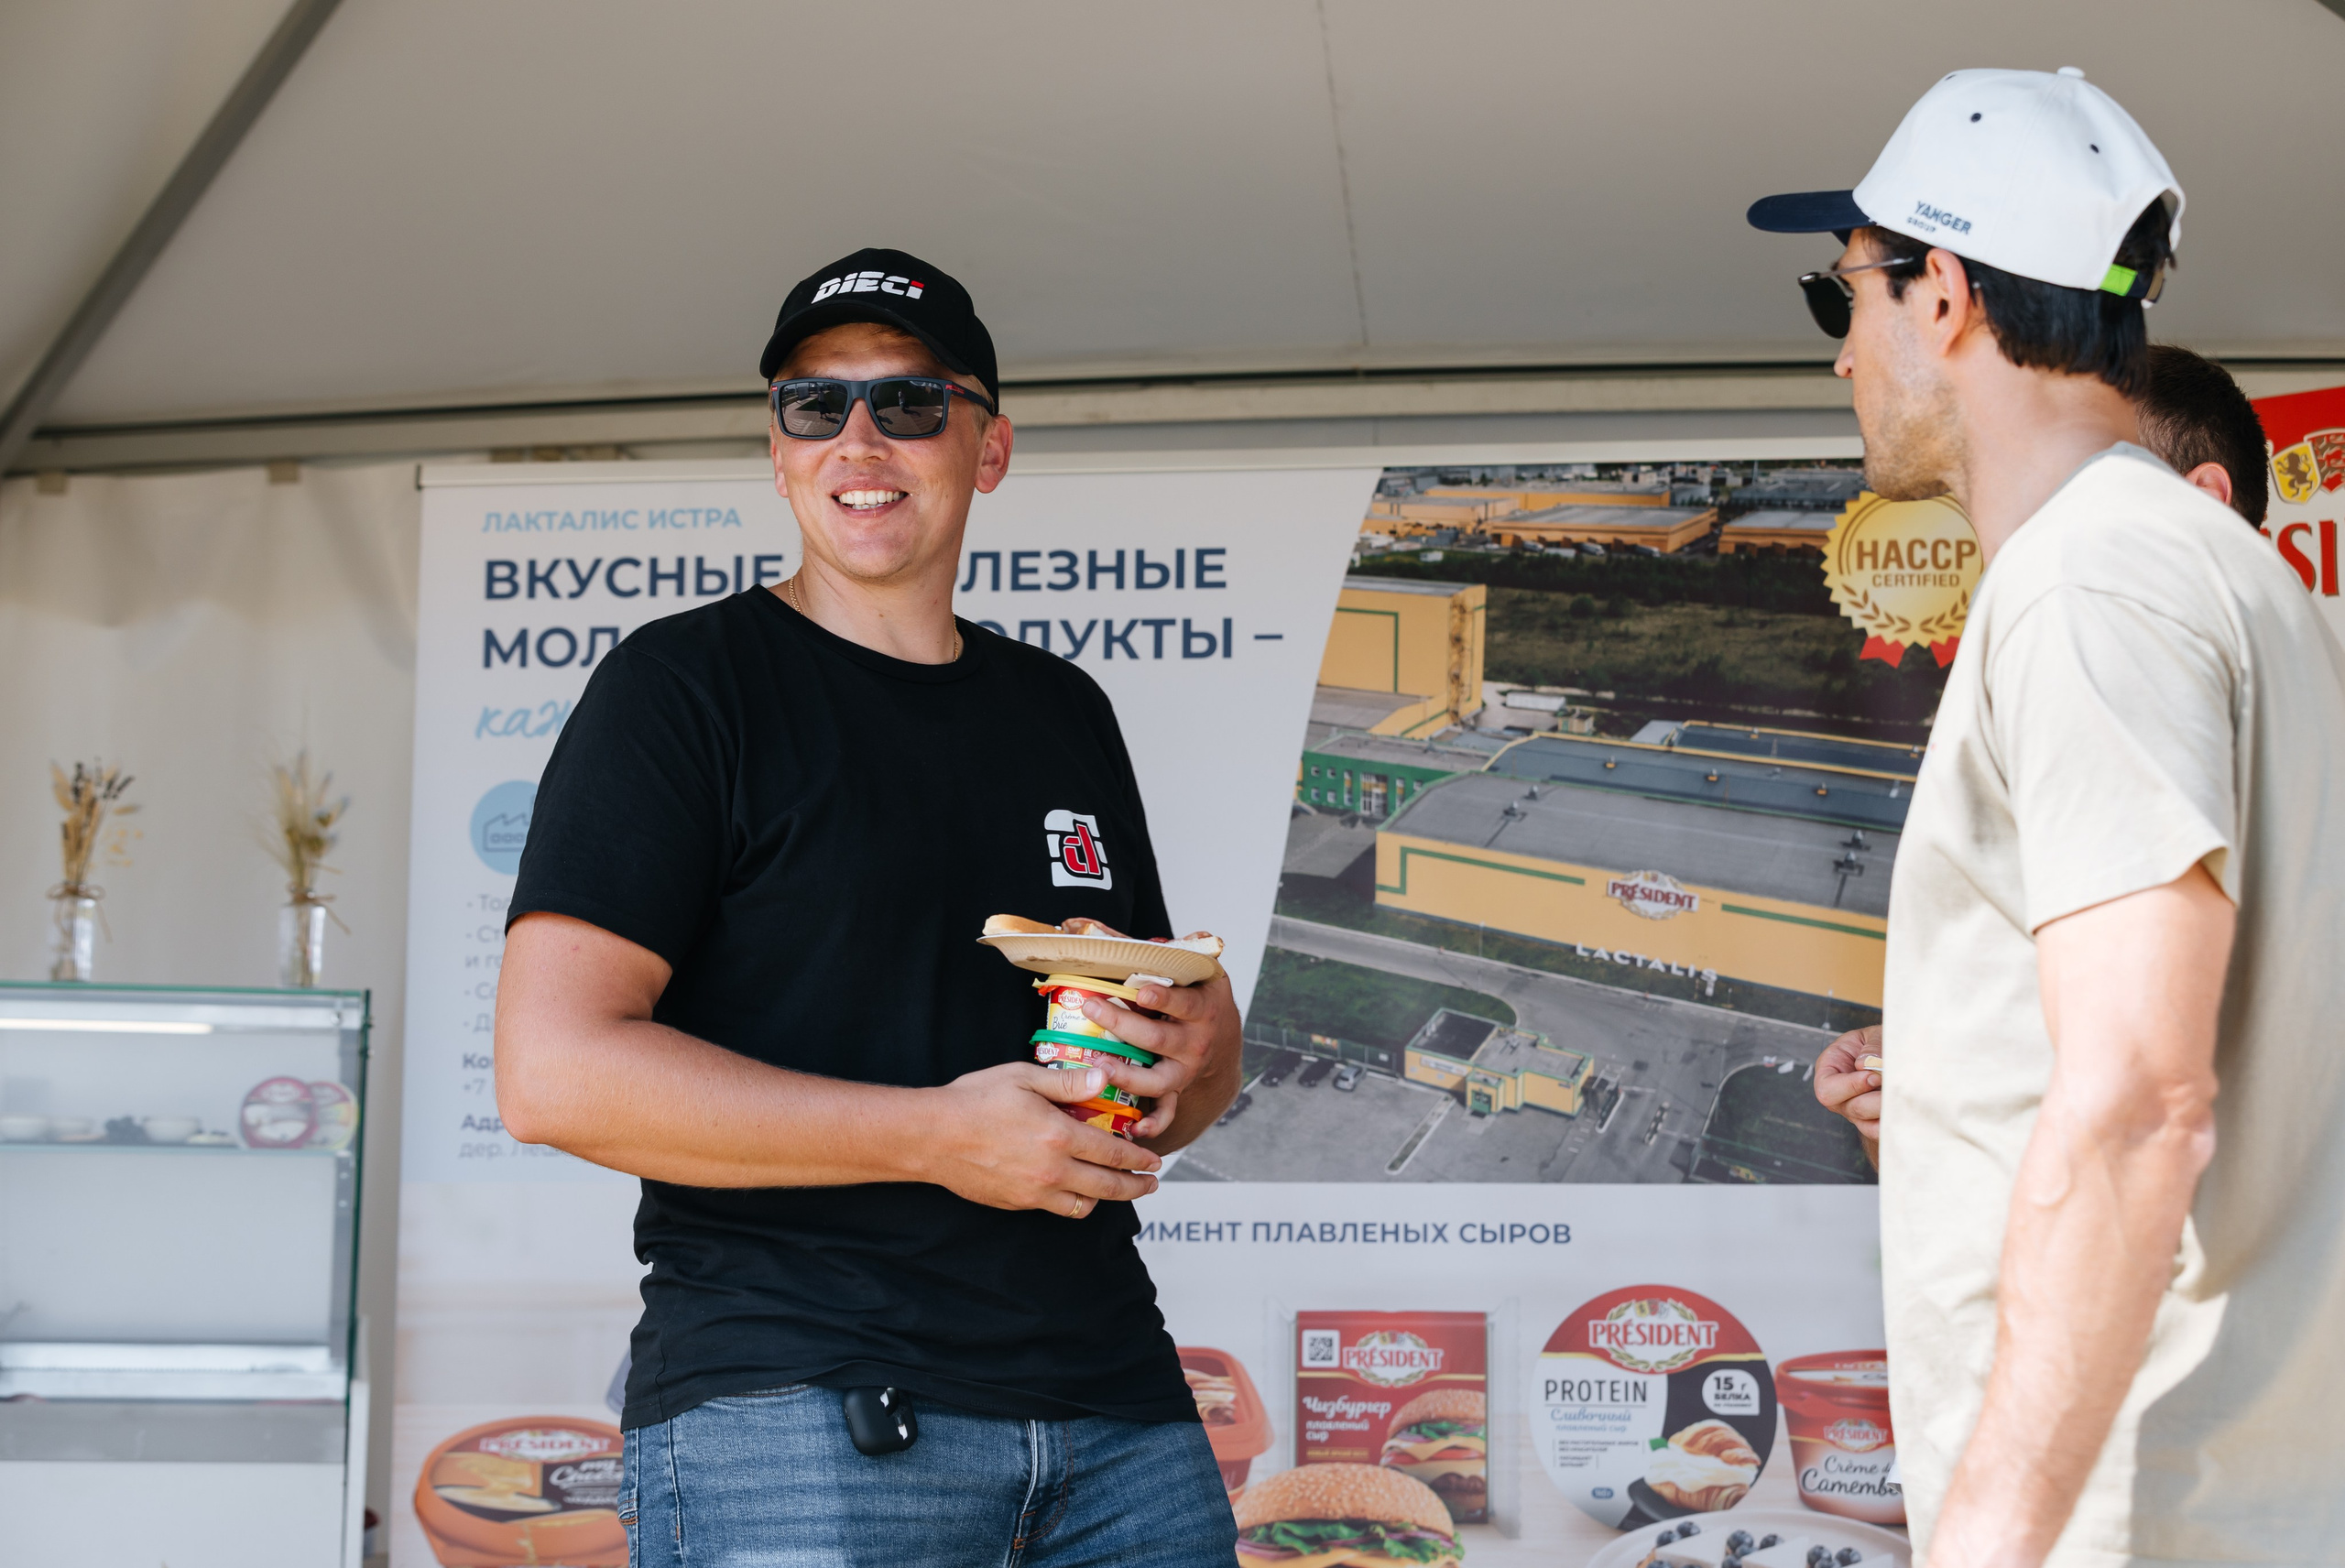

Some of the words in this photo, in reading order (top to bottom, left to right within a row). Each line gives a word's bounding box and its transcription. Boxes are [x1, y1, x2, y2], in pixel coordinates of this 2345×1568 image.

[482, 510, 639, 532] ЛАКТАЛИС
[648, 508, 742, 529] ИСТРА
[1856, 539, 1977, 571] HACCP
[485, 555, 783, 600] ВКУСНЫЕ
[954, 548, 1227, 593] ЛЕЗНЫЕ
[1872, 572, 1960, 587] CERTIFIED
[1611, 882, 1696, 909] PRÉSIDENT
[1576, 942, 1717, 983] LACTALIS
[1053, 1017, 1067, 1029] Brie
[1252, 1223, 1448, 1244] ПЛАВЛЕНЫХ
[1459, 1223, 1571, 1244] СЫРОВ
[1592, 1319, 1716, 1349] PRÉSIDENT
[1345, 1346, 1442, 1369] PRÉSIDENT
[1544, 1379, 1647, 1402] PROTEIN
[1714, 1377, 1734, 1390] 15
[1825, 1455, 1878, 1474] Crème
